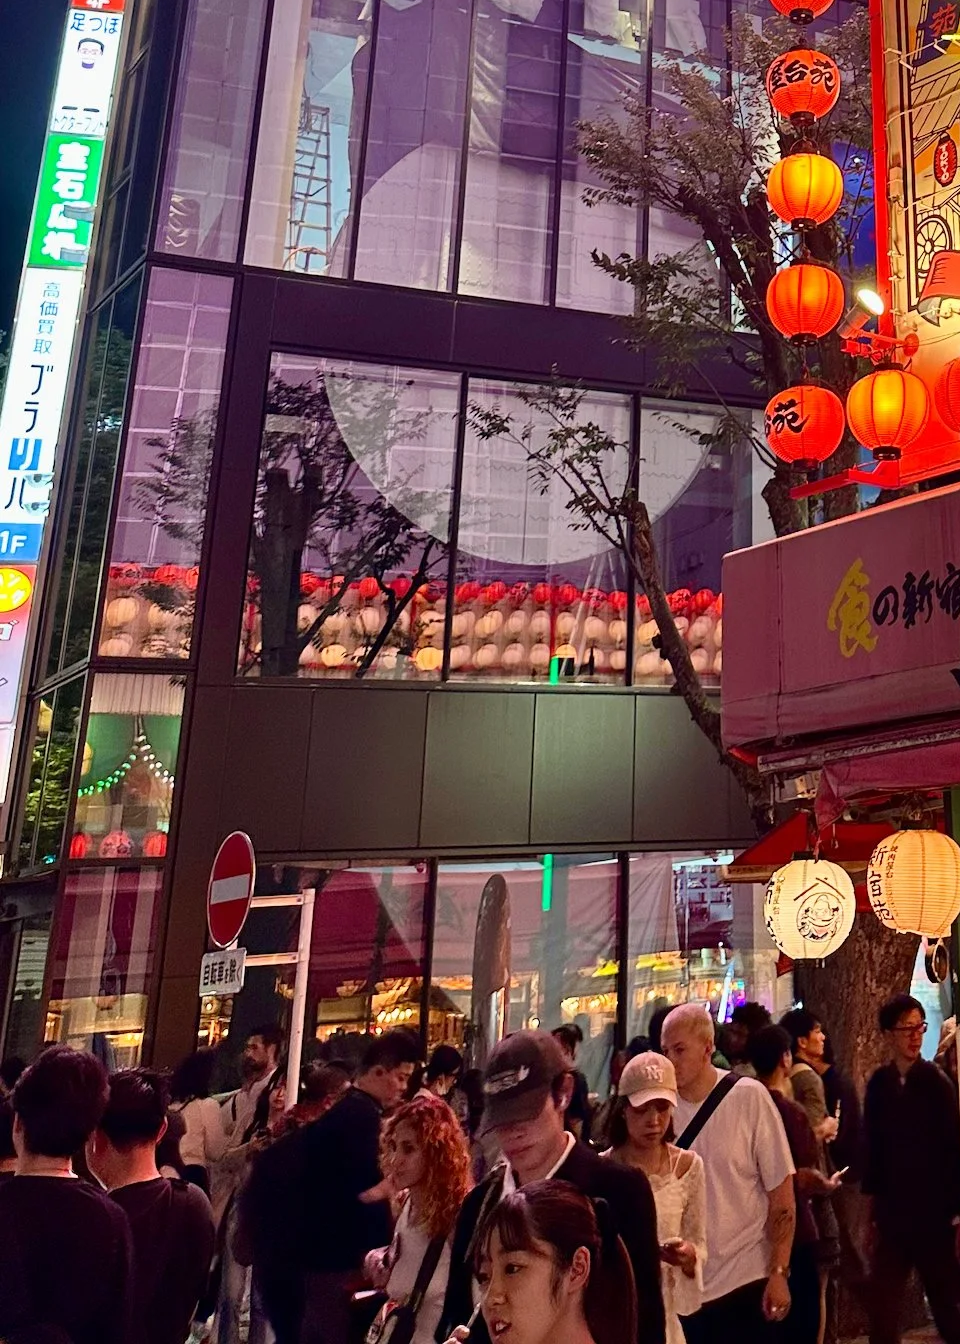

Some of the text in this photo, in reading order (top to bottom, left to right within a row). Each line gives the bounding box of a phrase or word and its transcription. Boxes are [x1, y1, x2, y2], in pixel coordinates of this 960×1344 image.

[768, 59, 835, 99] 屋台苑
[939, 143, 950, 181] TOKYO
[33, 282, 61, 355] 高価買取
[0, 530, 27, 555] 1F
